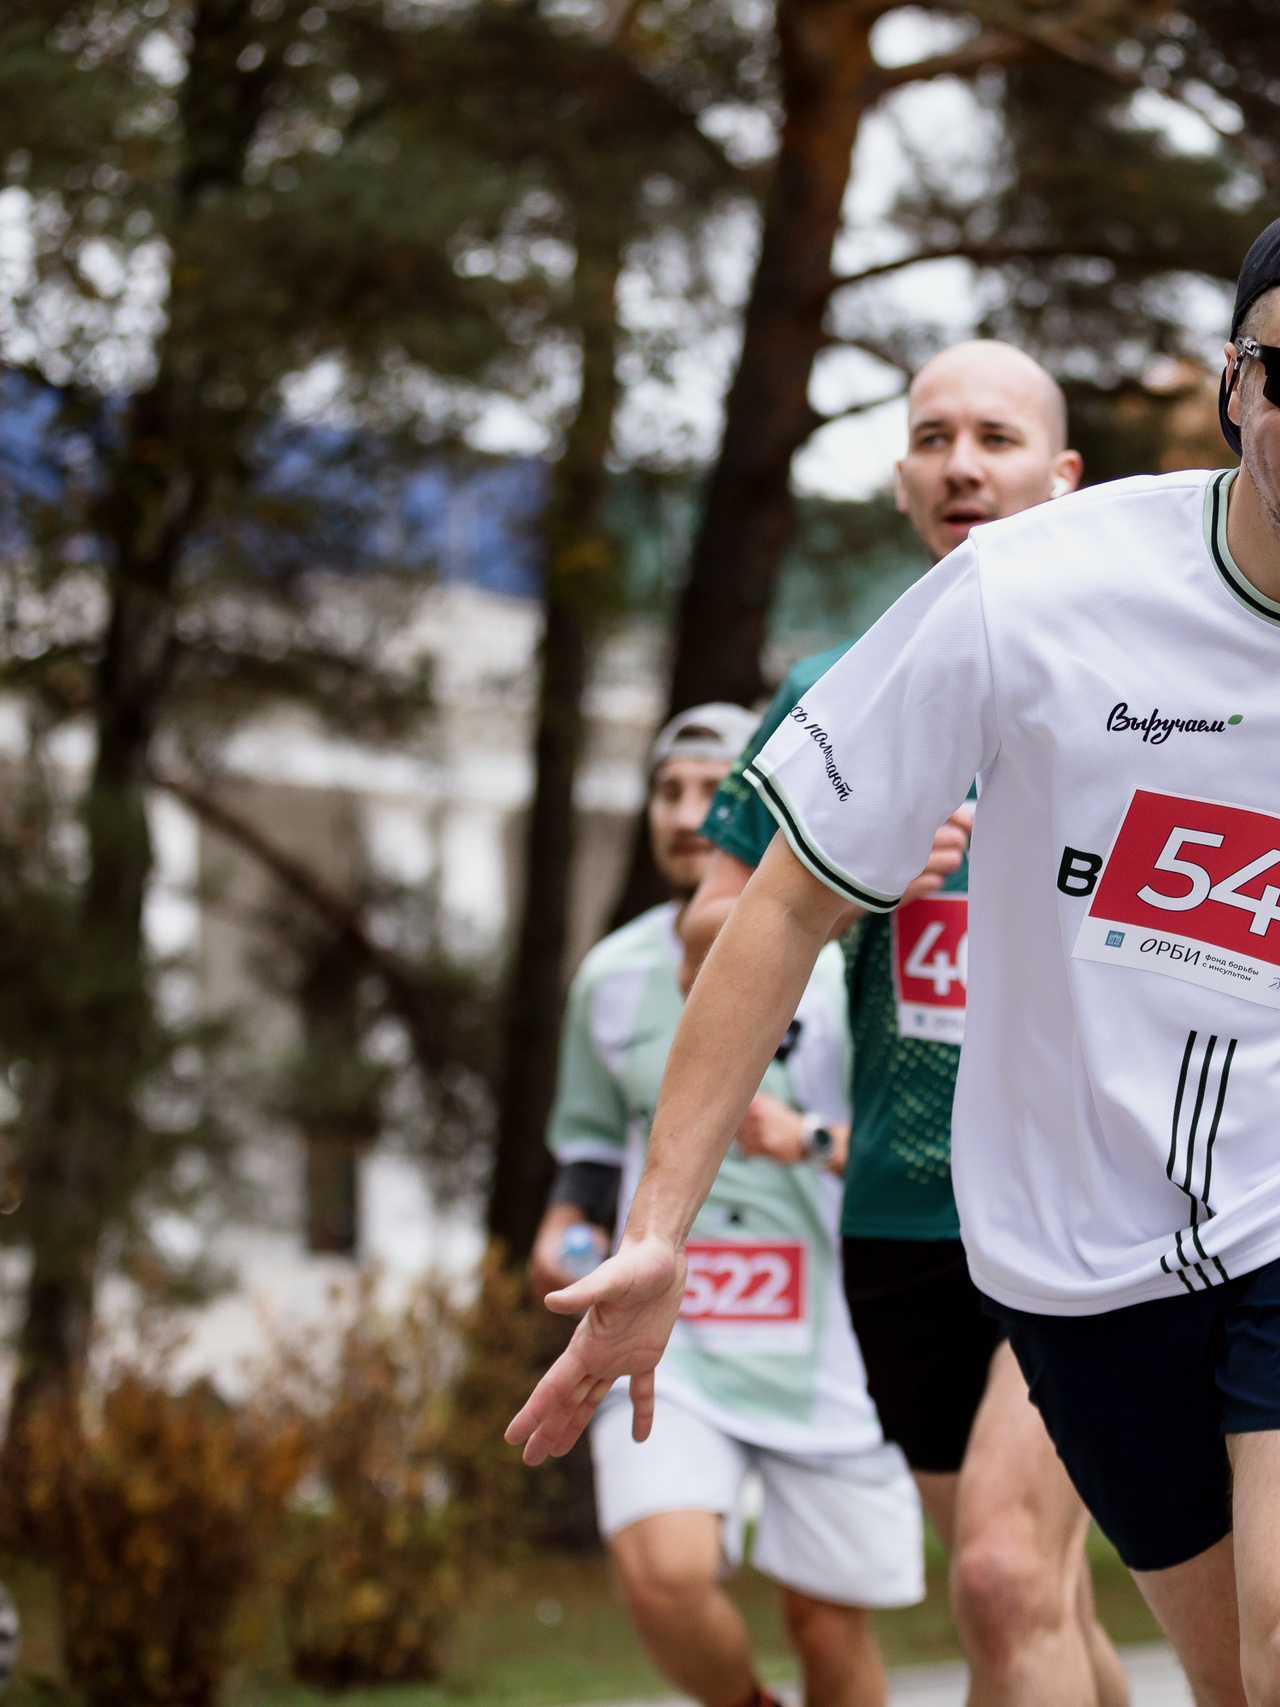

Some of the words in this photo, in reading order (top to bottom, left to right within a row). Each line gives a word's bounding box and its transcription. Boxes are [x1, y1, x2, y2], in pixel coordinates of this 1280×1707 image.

[789, 705, 809, 723] сь
[1106, 702, 1226, 745] Выручаем
[1139, 938, 1202, 966] ОРБИ
[1204, 953, 1228, 967] фонд
[1228, 960, 1260, 977] борьбы
[1208, 964, 1252, 982] инсультом
[679, 1253, 794, 1316] 522
